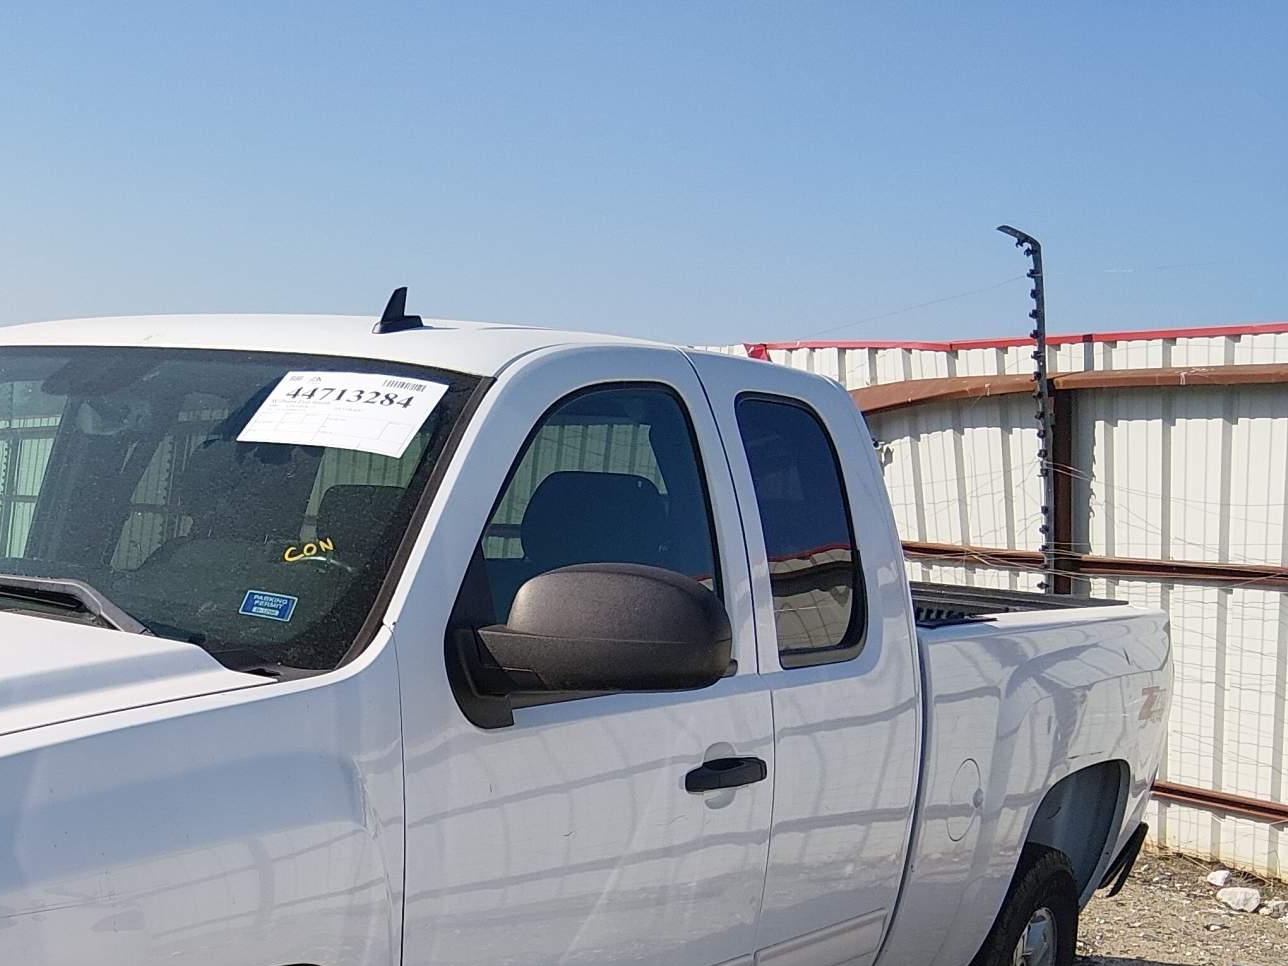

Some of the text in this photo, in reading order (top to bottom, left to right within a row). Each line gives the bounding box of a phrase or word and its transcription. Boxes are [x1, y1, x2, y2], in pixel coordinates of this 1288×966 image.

[286, 386, 414, 409] 44713284
[284, 537, 334, 562] CON
[253, 594, 288, 606] PARKING
[253, 600, 283, 609] PERMIT
